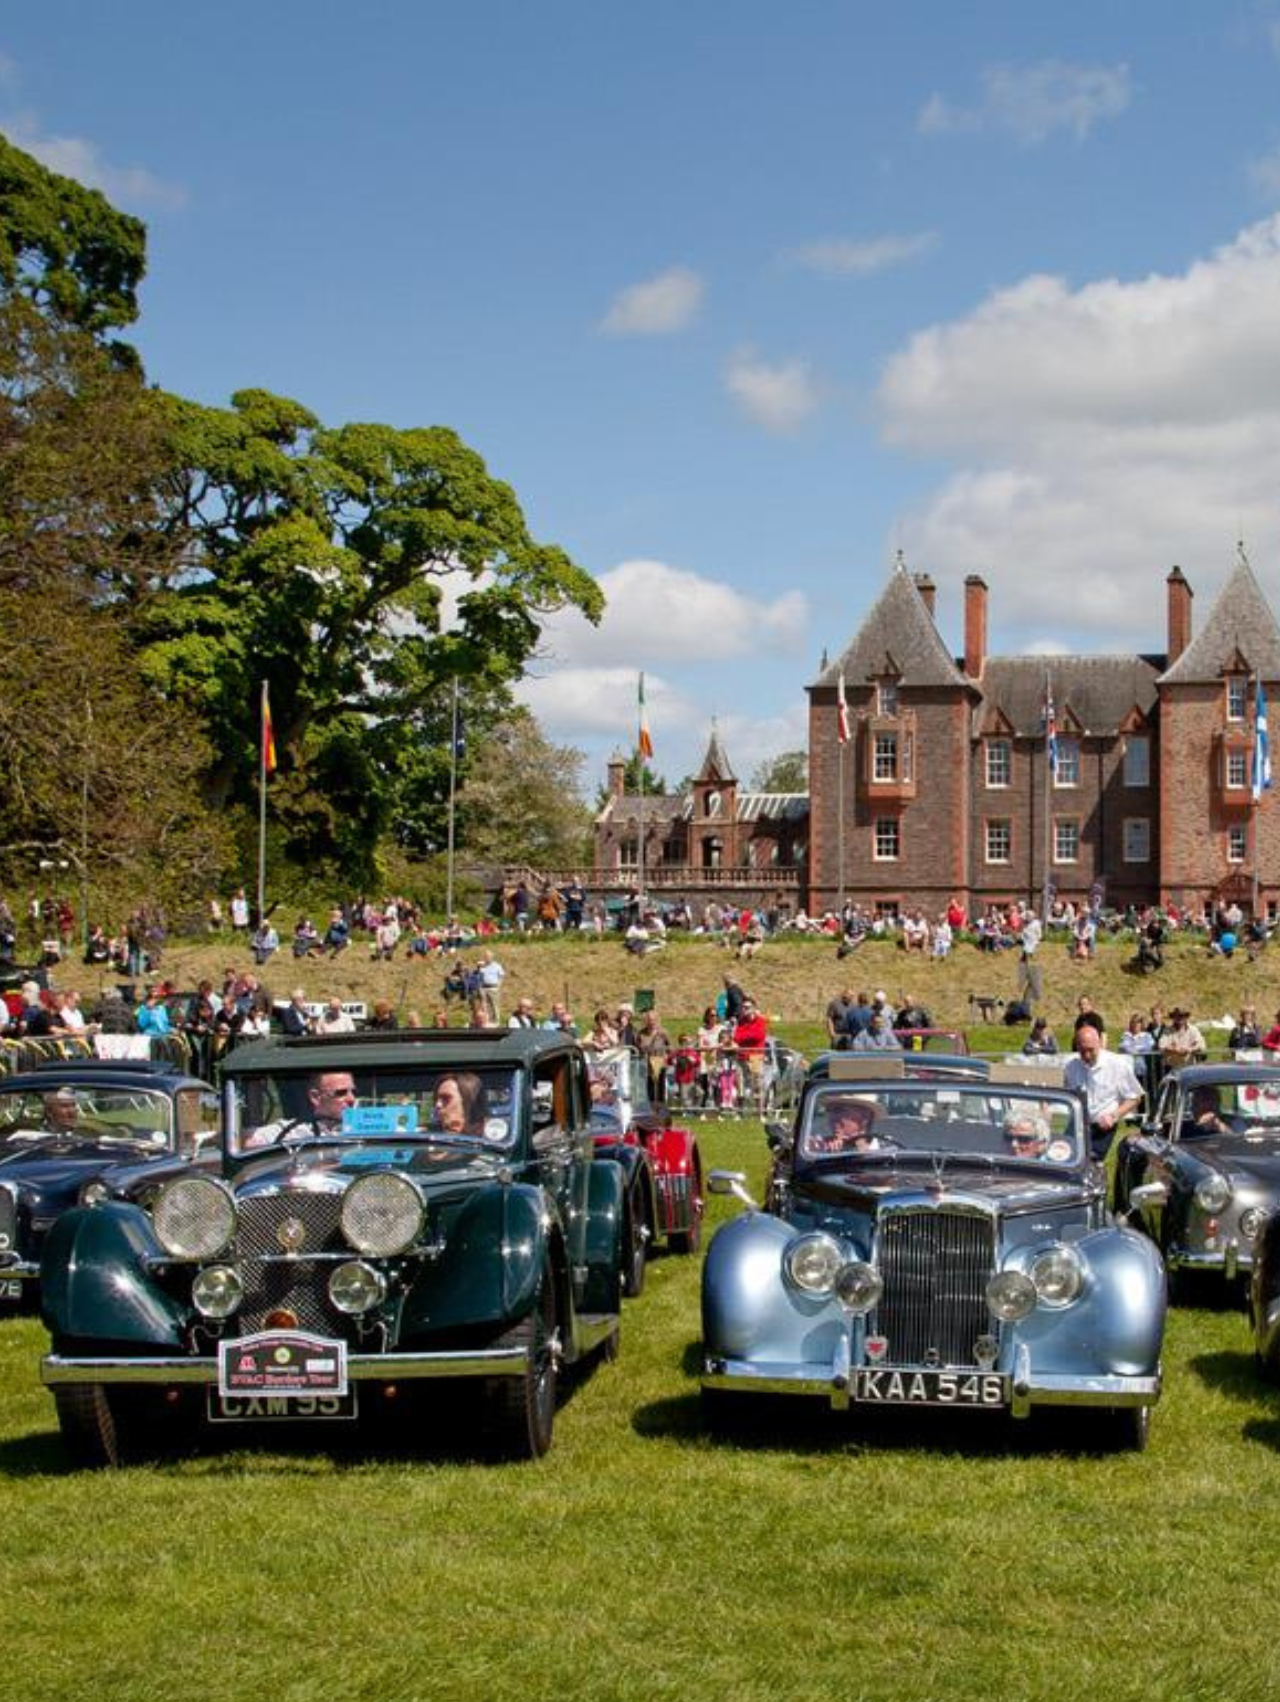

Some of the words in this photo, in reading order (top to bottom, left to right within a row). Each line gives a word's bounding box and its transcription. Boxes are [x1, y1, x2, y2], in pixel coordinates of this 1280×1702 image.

[863, 1371, 928, 1400] KAA
[937, 1373, 1003, 1402] 546
[220, 1396, 289, 1416] CXM
